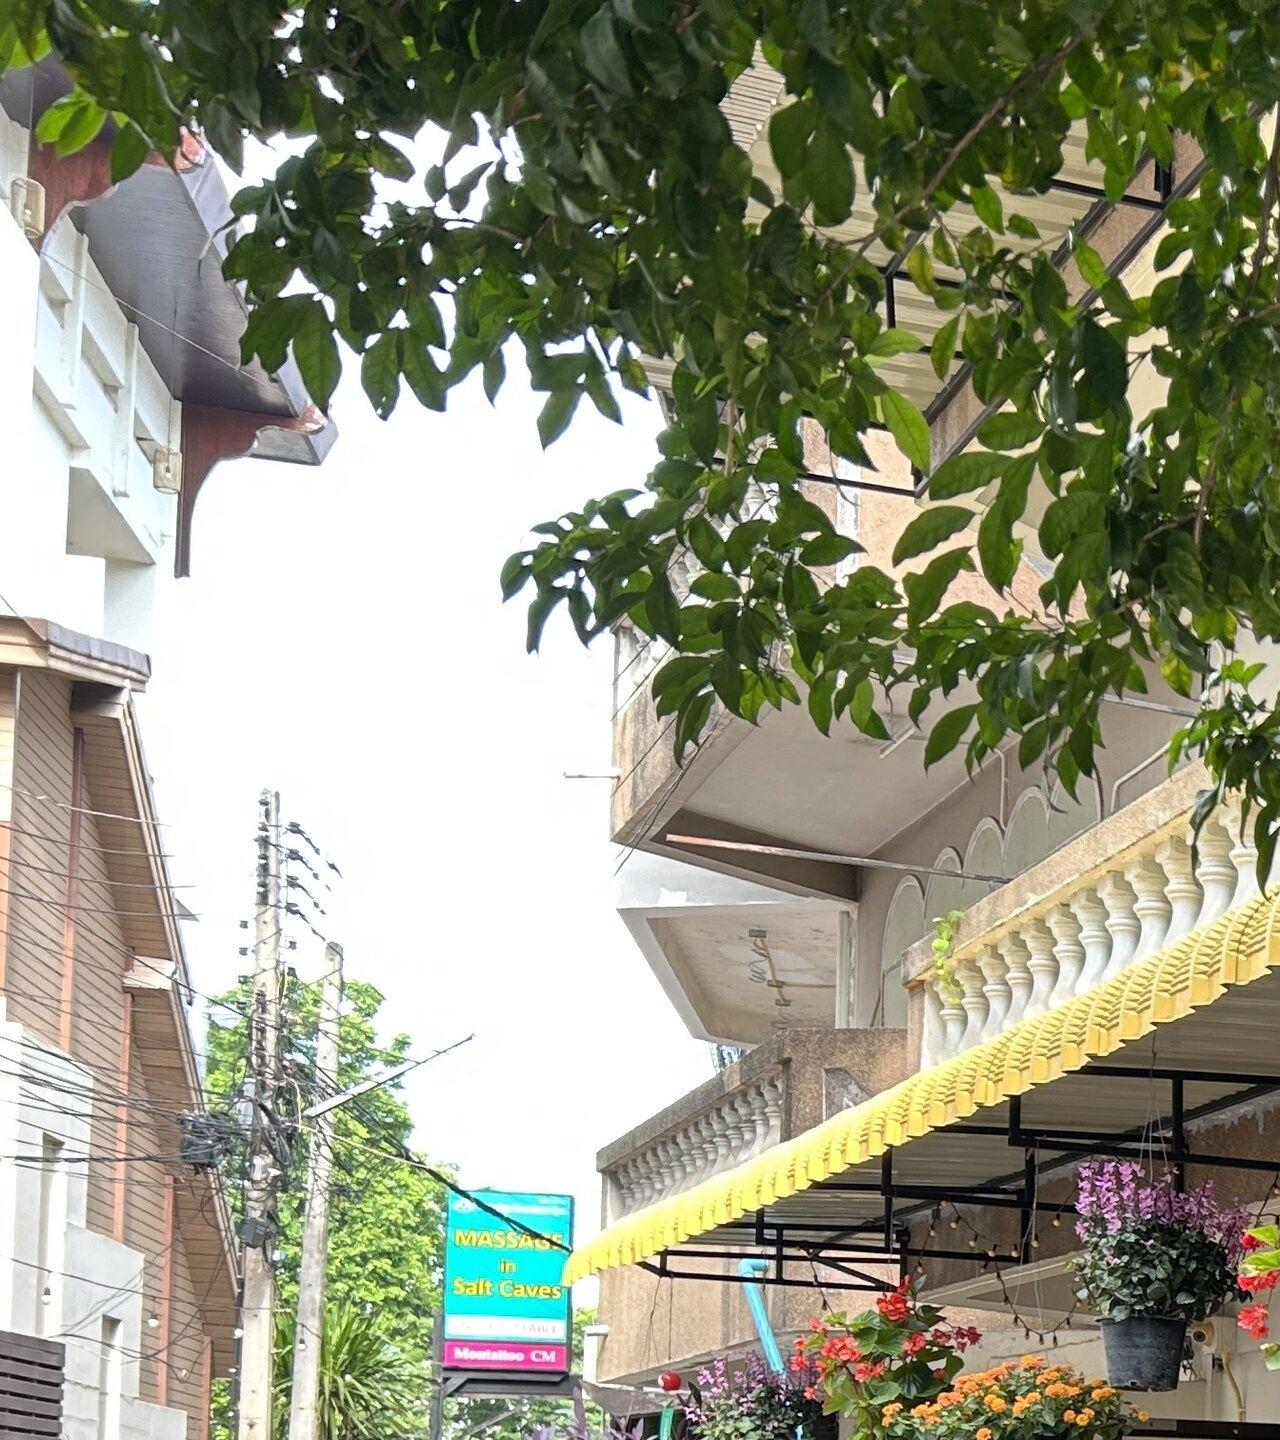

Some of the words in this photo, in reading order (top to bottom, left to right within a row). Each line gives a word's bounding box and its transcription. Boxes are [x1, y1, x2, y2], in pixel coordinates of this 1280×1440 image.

[499, 1257, 517, 1273] in
[452, 1277, 494, 1297] Salt
[498, 1279, 563, 1299] Caves
[530, 1349, 557, 1362] CM
